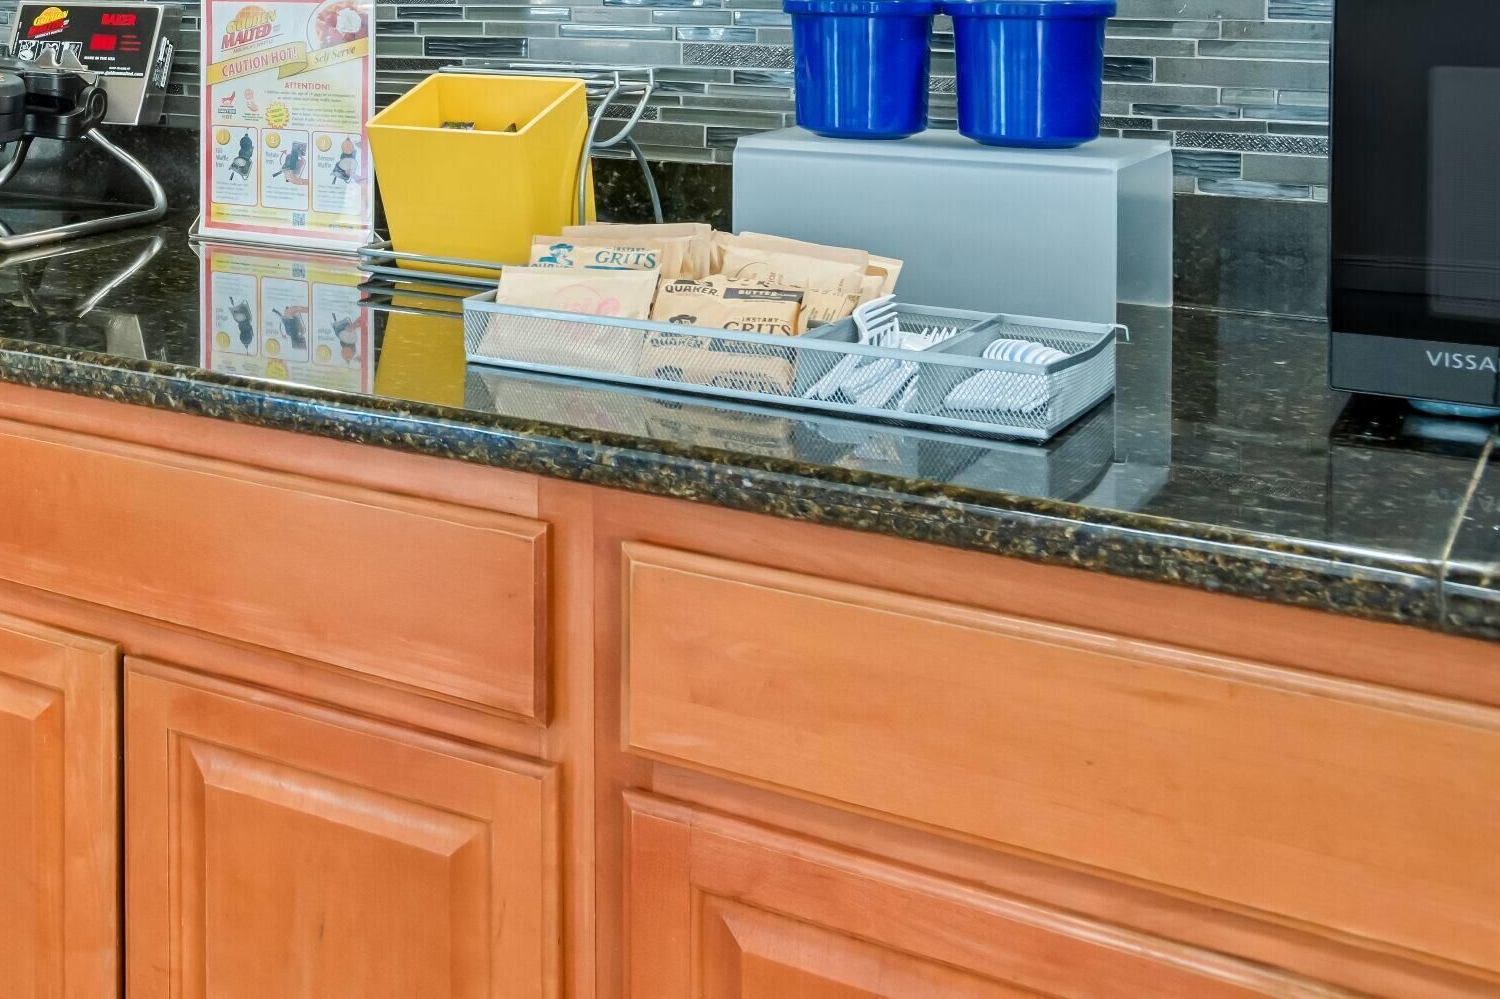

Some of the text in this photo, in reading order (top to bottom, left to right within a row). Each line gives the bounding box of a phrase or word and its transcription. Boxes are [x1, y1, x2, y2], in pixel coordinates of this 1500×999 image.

[101, 13, 137, 25] BAKER
[221, 23, 272, 50] MALTED
[222, 47, 298, 77] CAUTION HOT!
[314, 45, 356, 64] Self Serve
[285, 81, 331, 91] ATTENTION!
[595, 250, 656, 269] GRITS
[665, 285, 718, 296] QUAKER
[738, 289, 777, 298] BUTTER
[1425, 350, 1500, 373] VISSA
